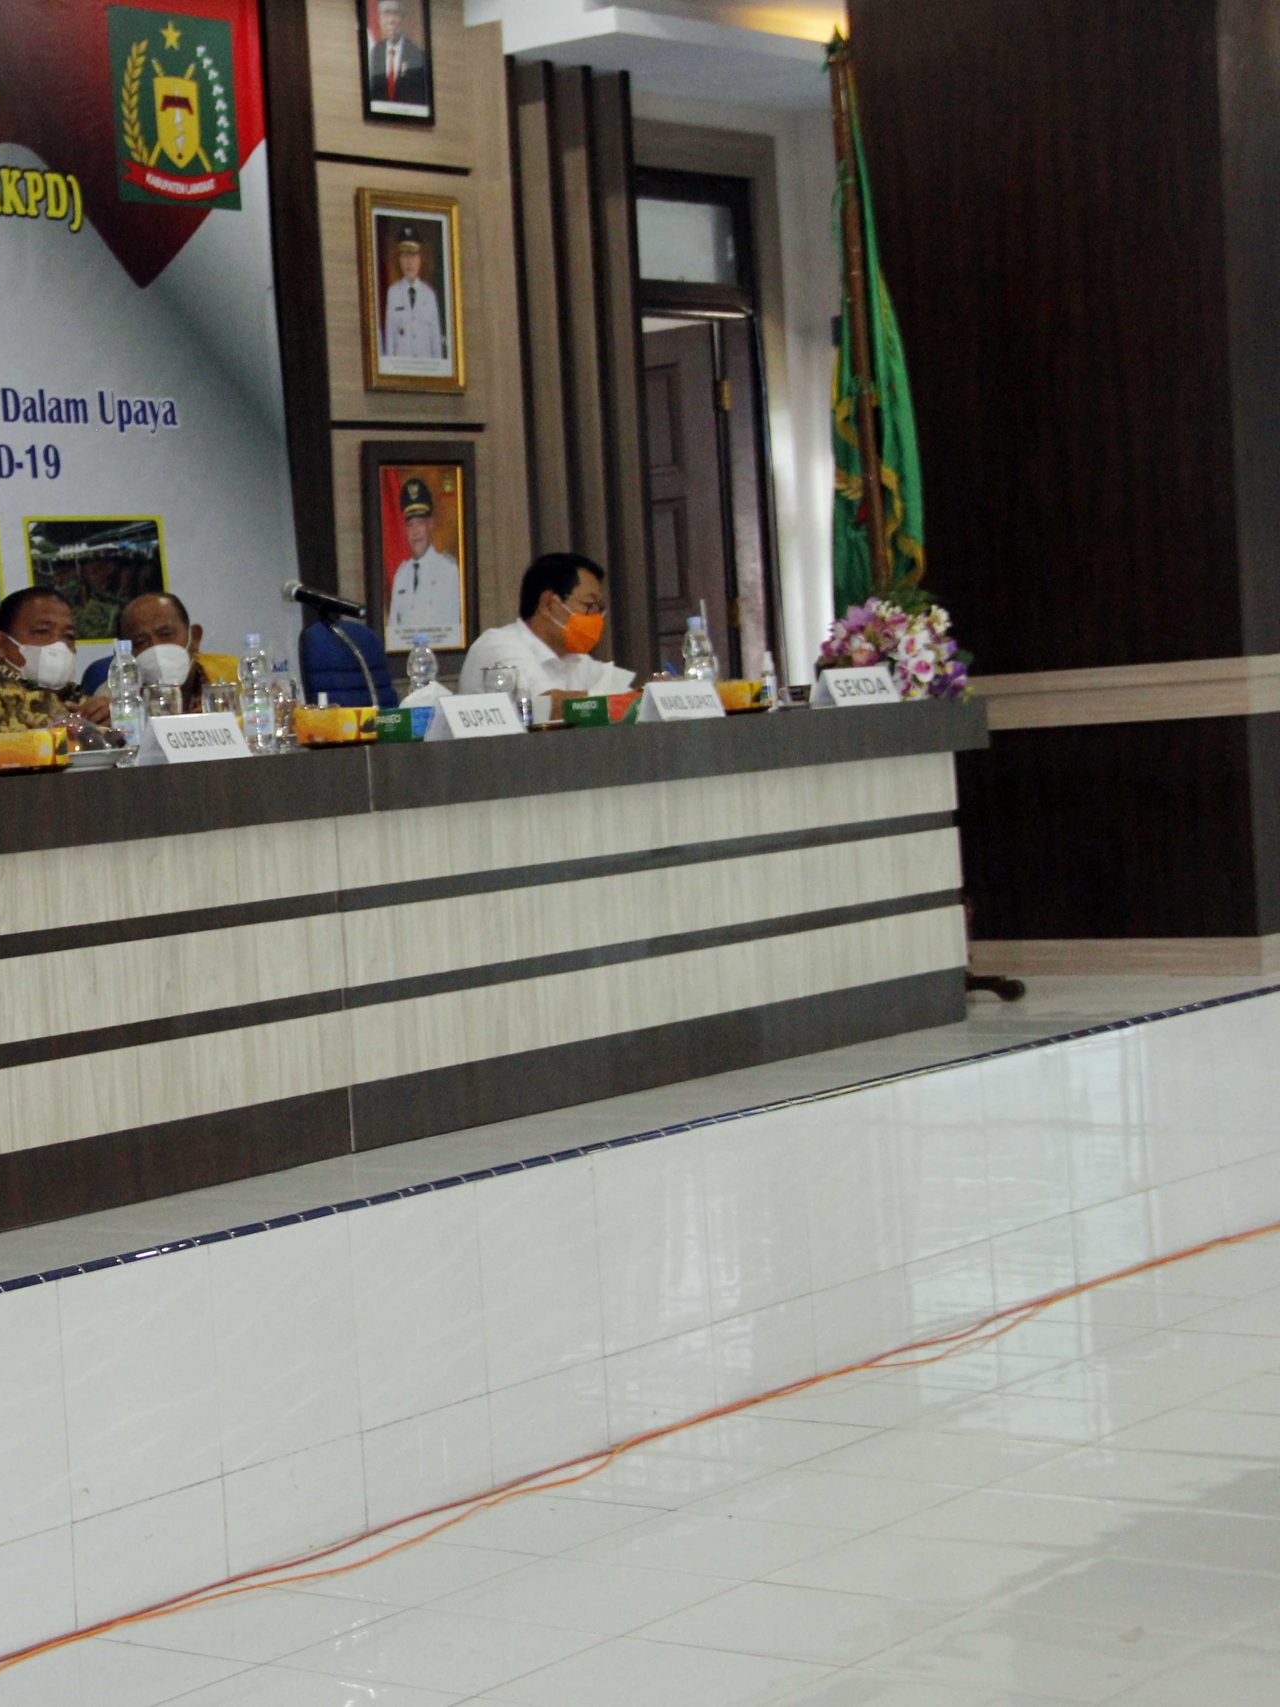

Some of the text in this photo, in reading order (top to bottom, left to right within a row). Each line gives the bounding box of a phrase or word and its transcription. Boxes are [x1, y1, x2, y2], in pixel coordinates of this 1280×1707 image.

[0, 386, 90, 425] Dalam
[97, 390, 179, 434] Upaya
[833, 676, 890, 698] SEKDA
[458, 707, 507, 728] BUPATI
[166, 728, 237, 750] GUBERNUR
